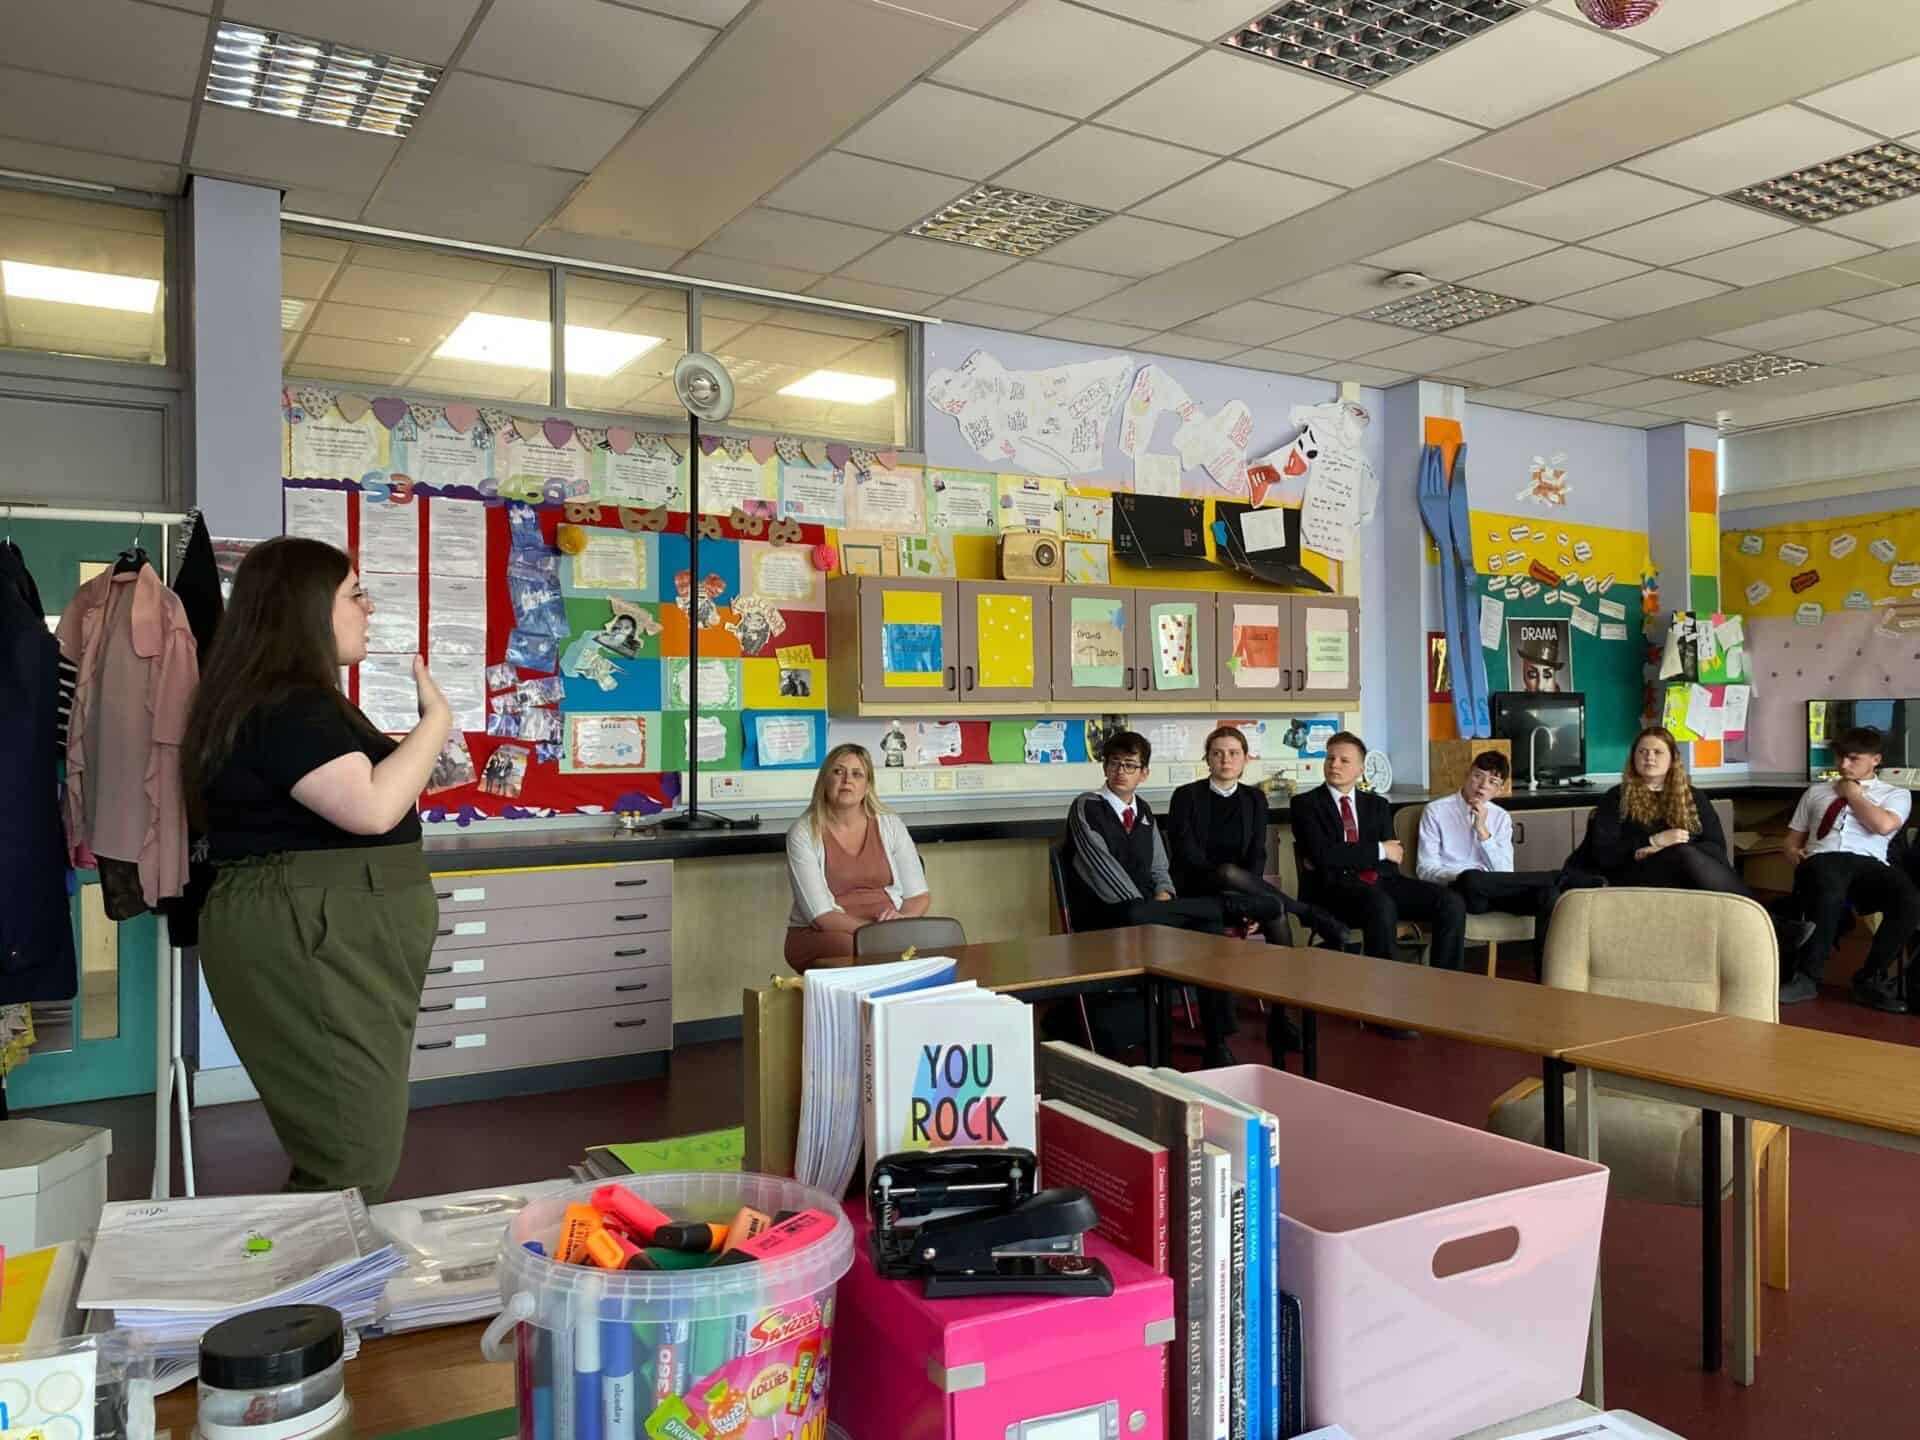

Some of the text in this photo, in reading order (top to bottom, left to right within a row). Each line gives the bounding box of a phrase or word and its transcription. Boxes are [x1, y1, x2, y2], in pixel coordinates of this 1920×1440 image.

[1521, 627, 1557, 640] DRAMA
[923, 1044, 993, 1088] YOU
[912, 1096, 1008, 1141] ROCK
[1233, 1193, 1244, 1274] THEATRE
[1190, 1145, 1202, 1416] THE ARRIVAL SHAUN TAN
[751, 1370, 788, 1400] LOLLIES
